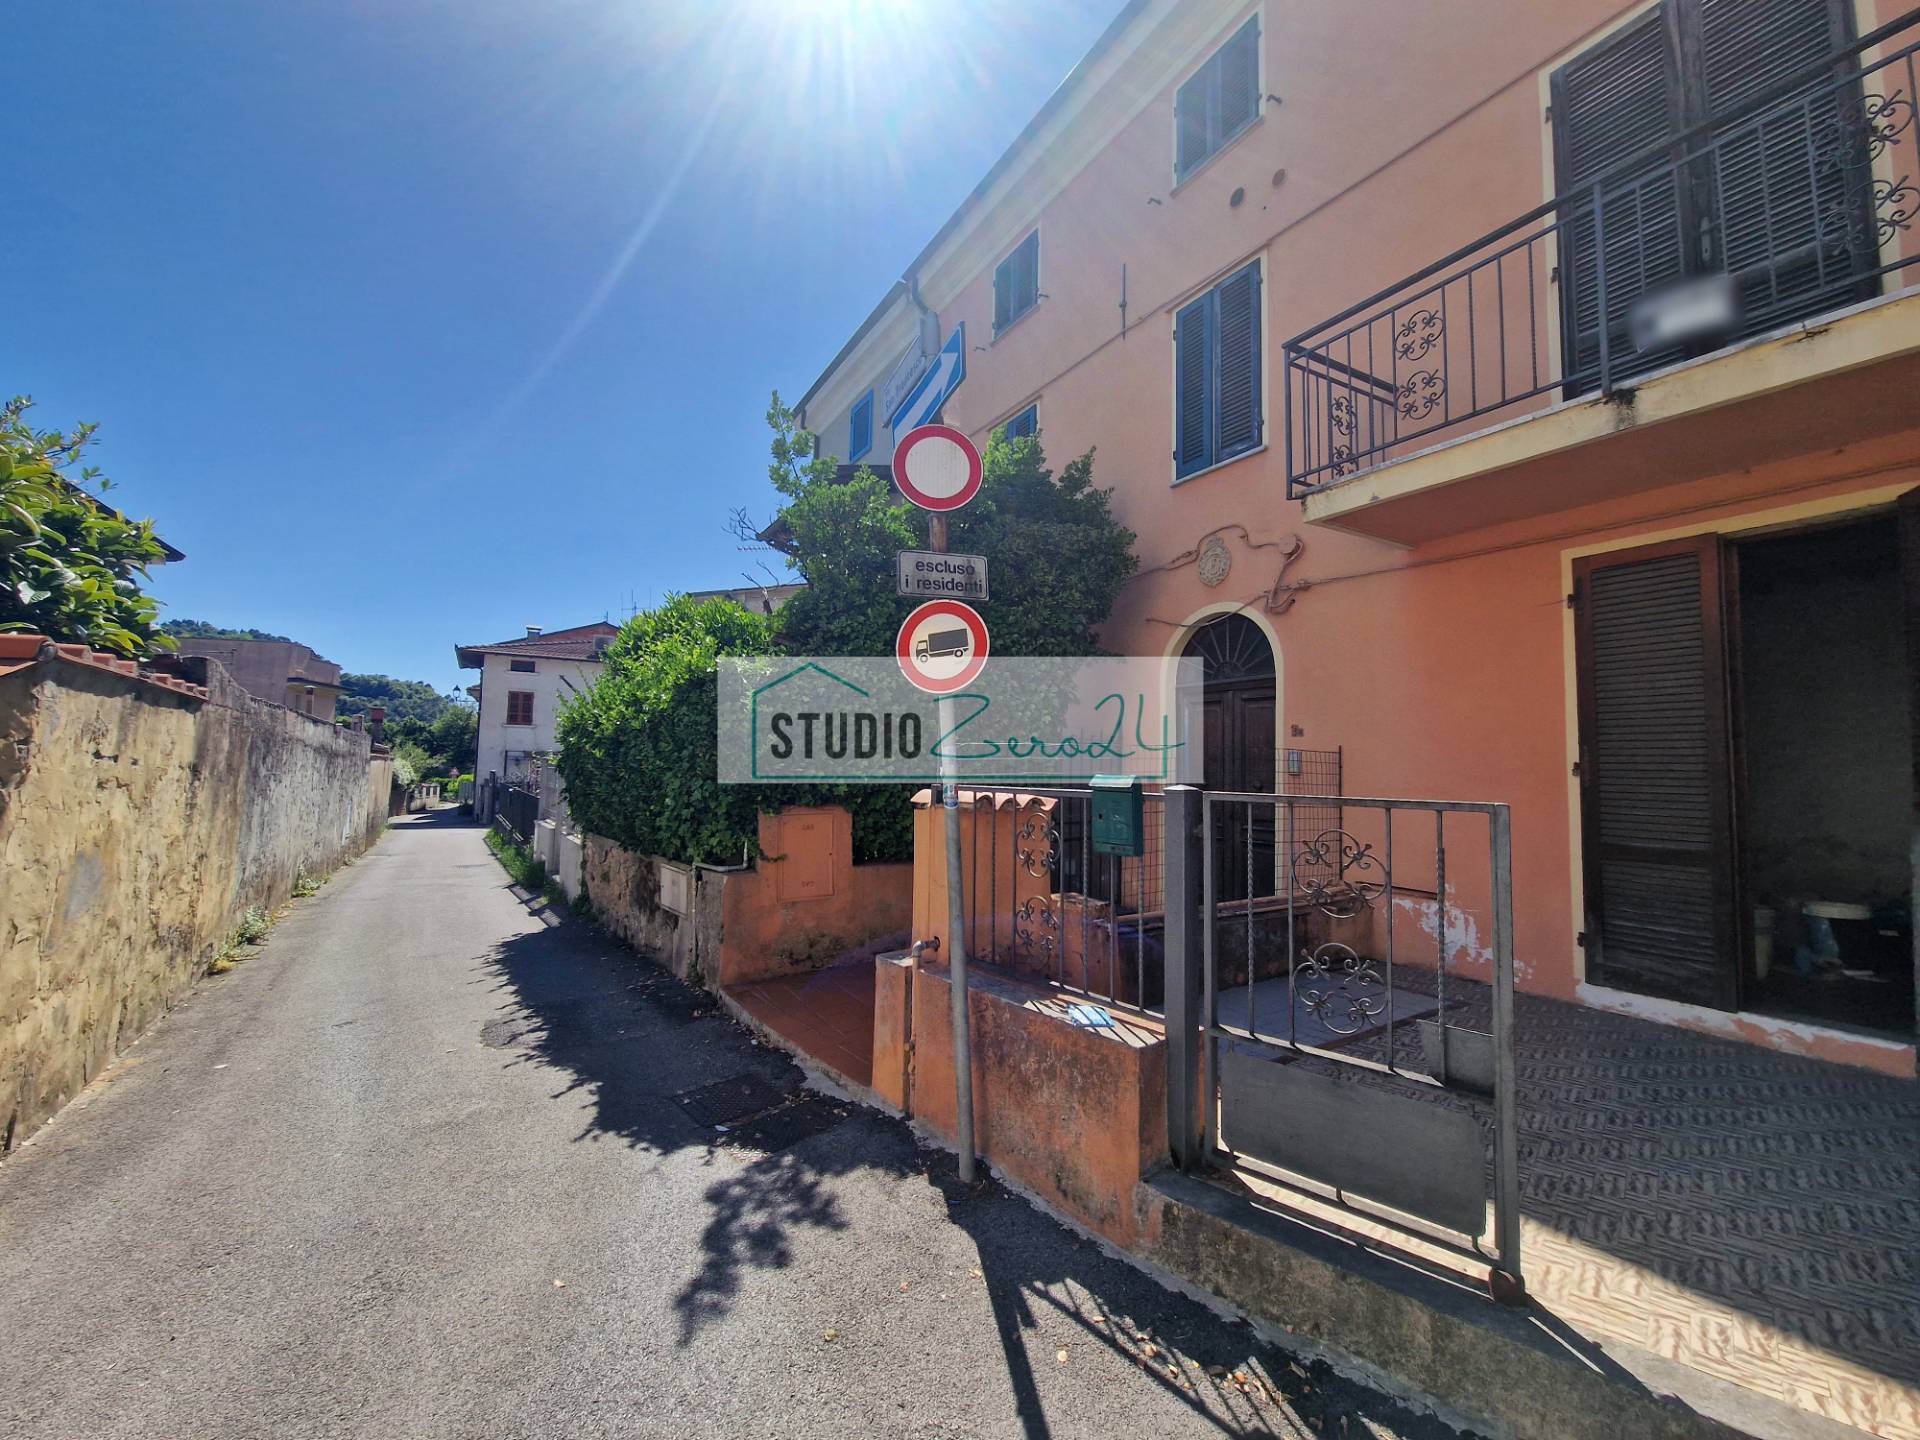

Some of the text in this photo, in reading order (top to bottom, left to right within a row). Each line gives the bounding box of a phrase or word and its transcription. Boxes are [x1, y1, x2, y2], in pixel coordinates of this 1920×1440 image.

[915, 560, 976, 575] escluso
[904, 574, 983, 593] i residenti
